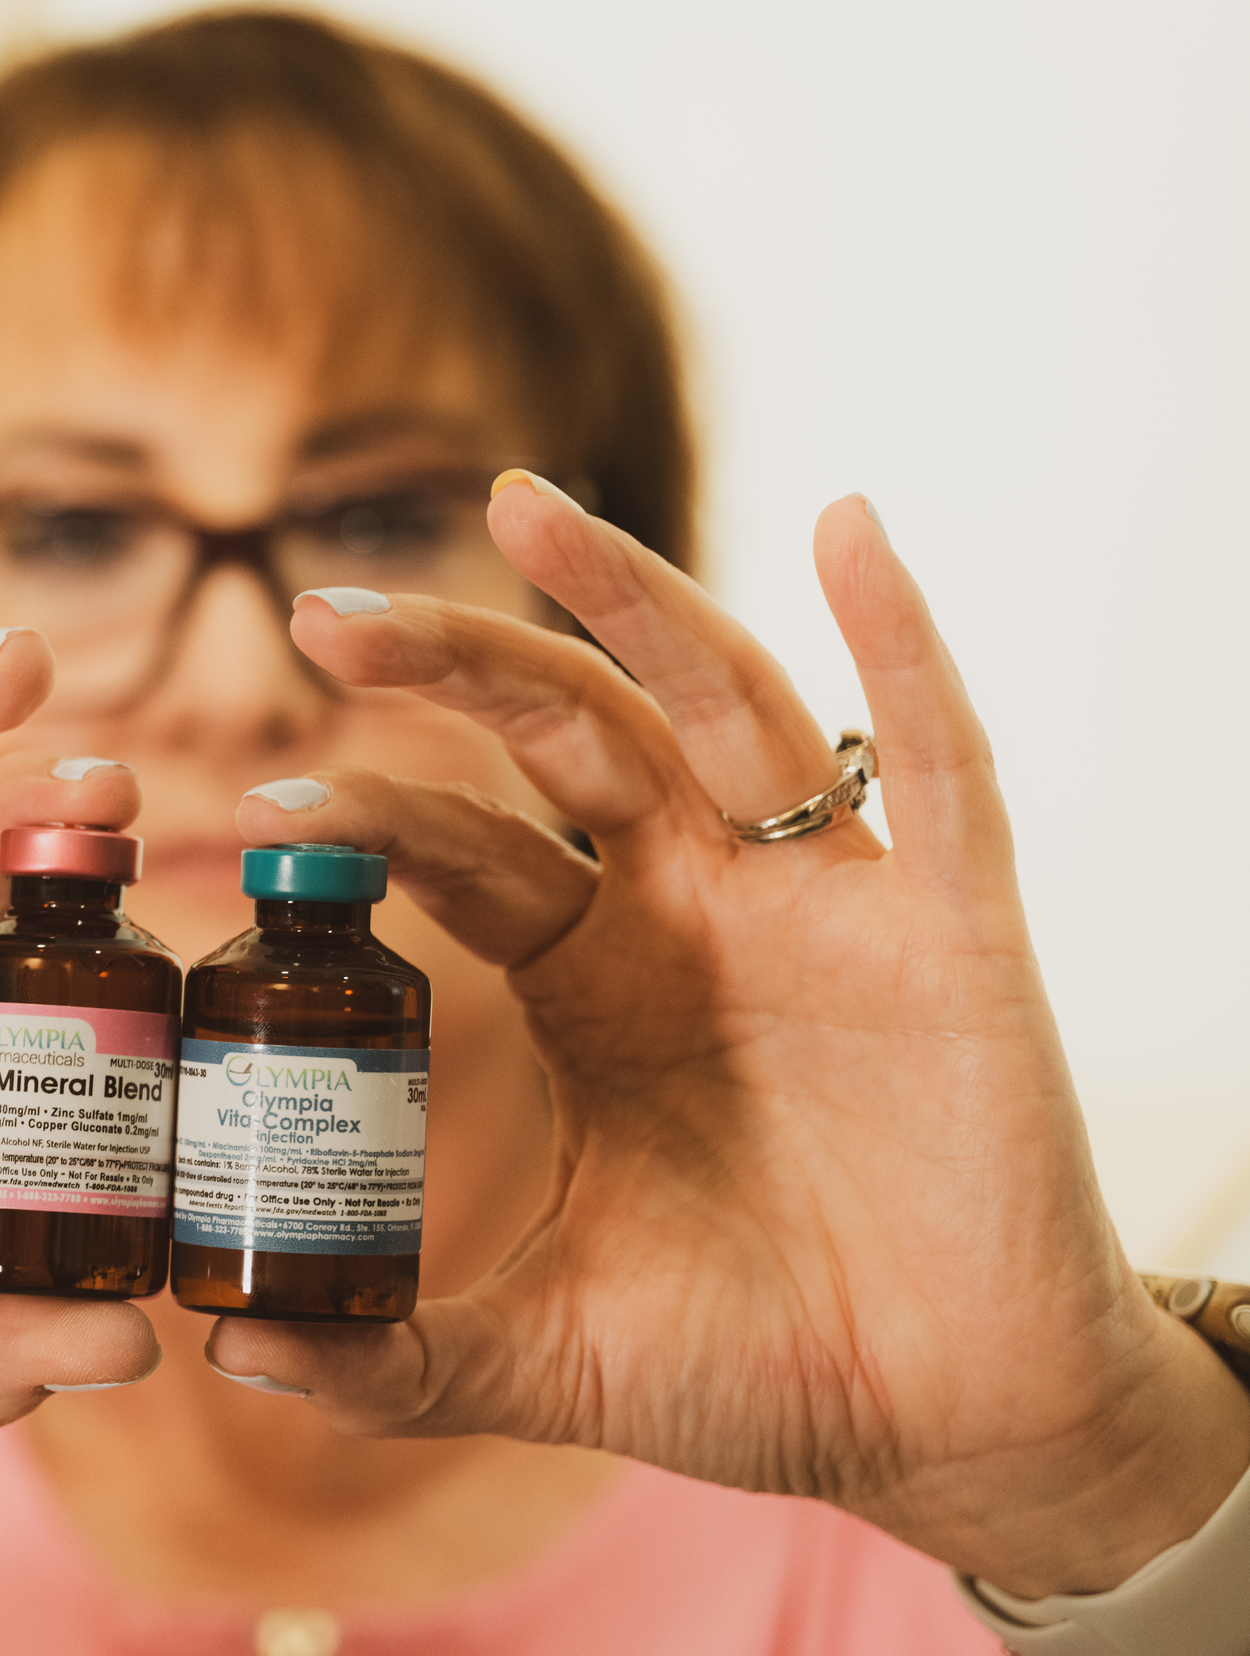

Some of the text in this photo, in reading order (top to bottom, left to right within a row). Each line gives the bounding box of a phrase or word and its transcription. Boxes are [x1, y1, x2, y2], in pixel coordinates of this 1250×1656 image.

[110, 1058, 154, 1071] MULTI-DOSE
[226, 1055, 353, 1092] OLYMPIA
[104, 1075, 162, 1102] Blend
[242, 1090, 333, 1115] Olympia
[51, 1107, 75, 1119] Zinc
[78, 1108, 114, 1121] Sulfate
[117, 1111, 148, 1125] 1mg/ml
[217, 1108, 361, 1136] Vita-Complex
[28, 1118, 67, 1132] Copper
[71, 1121, 122, 1134] Gluconate
[125, 1124, 159, 1139] 0.2mg/ml
[255, 1130, 313, 1145] Injection
[1, 1137, 30, 1147] Alcohol
[32, 1139, 44, 1149] NF,
[46, 1140, 71, 1150] Sterile
[73, 1141, 96, 1151] Water
[97, 1142, 108, 1152] for
[109, 1143, 138, 1154] Injection
[139, 1146, 151, 1155] USP
[259, 1145, 302, 1156] 100mg/mL
[2, 1152, 44, 1164] temperature
[61, 1156, 67, 1165] to
[98, 1158, 104, 1168] to
[194, 1158, 221, 1169] contains:
[223, 1160, 233, 1170] 1%
[262, 1164, 299, 1175] Alcohol,
[301, 1166, 320, 1175] 78%
[321, 1166, 347, 1176] Sterile
[349, 1167, 373, 1177] Water
[374, 1167, 384, 1177] for
[385, 1167, 410, 1178] Injection
[198, 1150, 243, 1161] Dexpanthenol
[286, 1156, 330, 1167] Pyridoxine
[332, 1158, 346, 1167] HCl
[347, 1158, 378, 1169] 2mg/mL
[21, 1167, 37, 1177] Use
[39, 1168, 58, 1180] Only
[68, 1170, 83, 1180] Not
[84, 1171, 98, 1181] For
[100, 1172, 125, 1183] Resale
[131, 1174, 140, 1184] Rx
[141, 1175, 154, 1187] Only
[202, 1173, 232, 1184] controlled
[254, 1178, 299, 1189] emperature
[317, 1181, 325, 1190] to
[359, 1182, 367, 1190] to
[178, 1188, 214, 1199] compounded
[215, 1191, 234, 1203] drug
[244, 1193, 258, 1203] Fr
[260, 1194, 290, 1205] Office
[292, 1196, 310, 1206] Use
[312, 1197, 337, 1209] Only
[344, 1198, 362, 1208] Not
[362, 1198, 375, 1208] For
[377, 1198, 400, 1208] Resale
[188, 1200, 205, 1209] Adverse
[205, 1201, 223, 1210] Events
[255, 1205, 337, 1217] www.fda.gov/medwatch
[187, 1212, 211, 1224] Olympia
[305, 1222, 338, 1233] Conroy
[356, 1223, 371, 1233] Ste.
[196, 1223, 375, 1241] 1-888-323-778 www.olympiapharmacy.com
